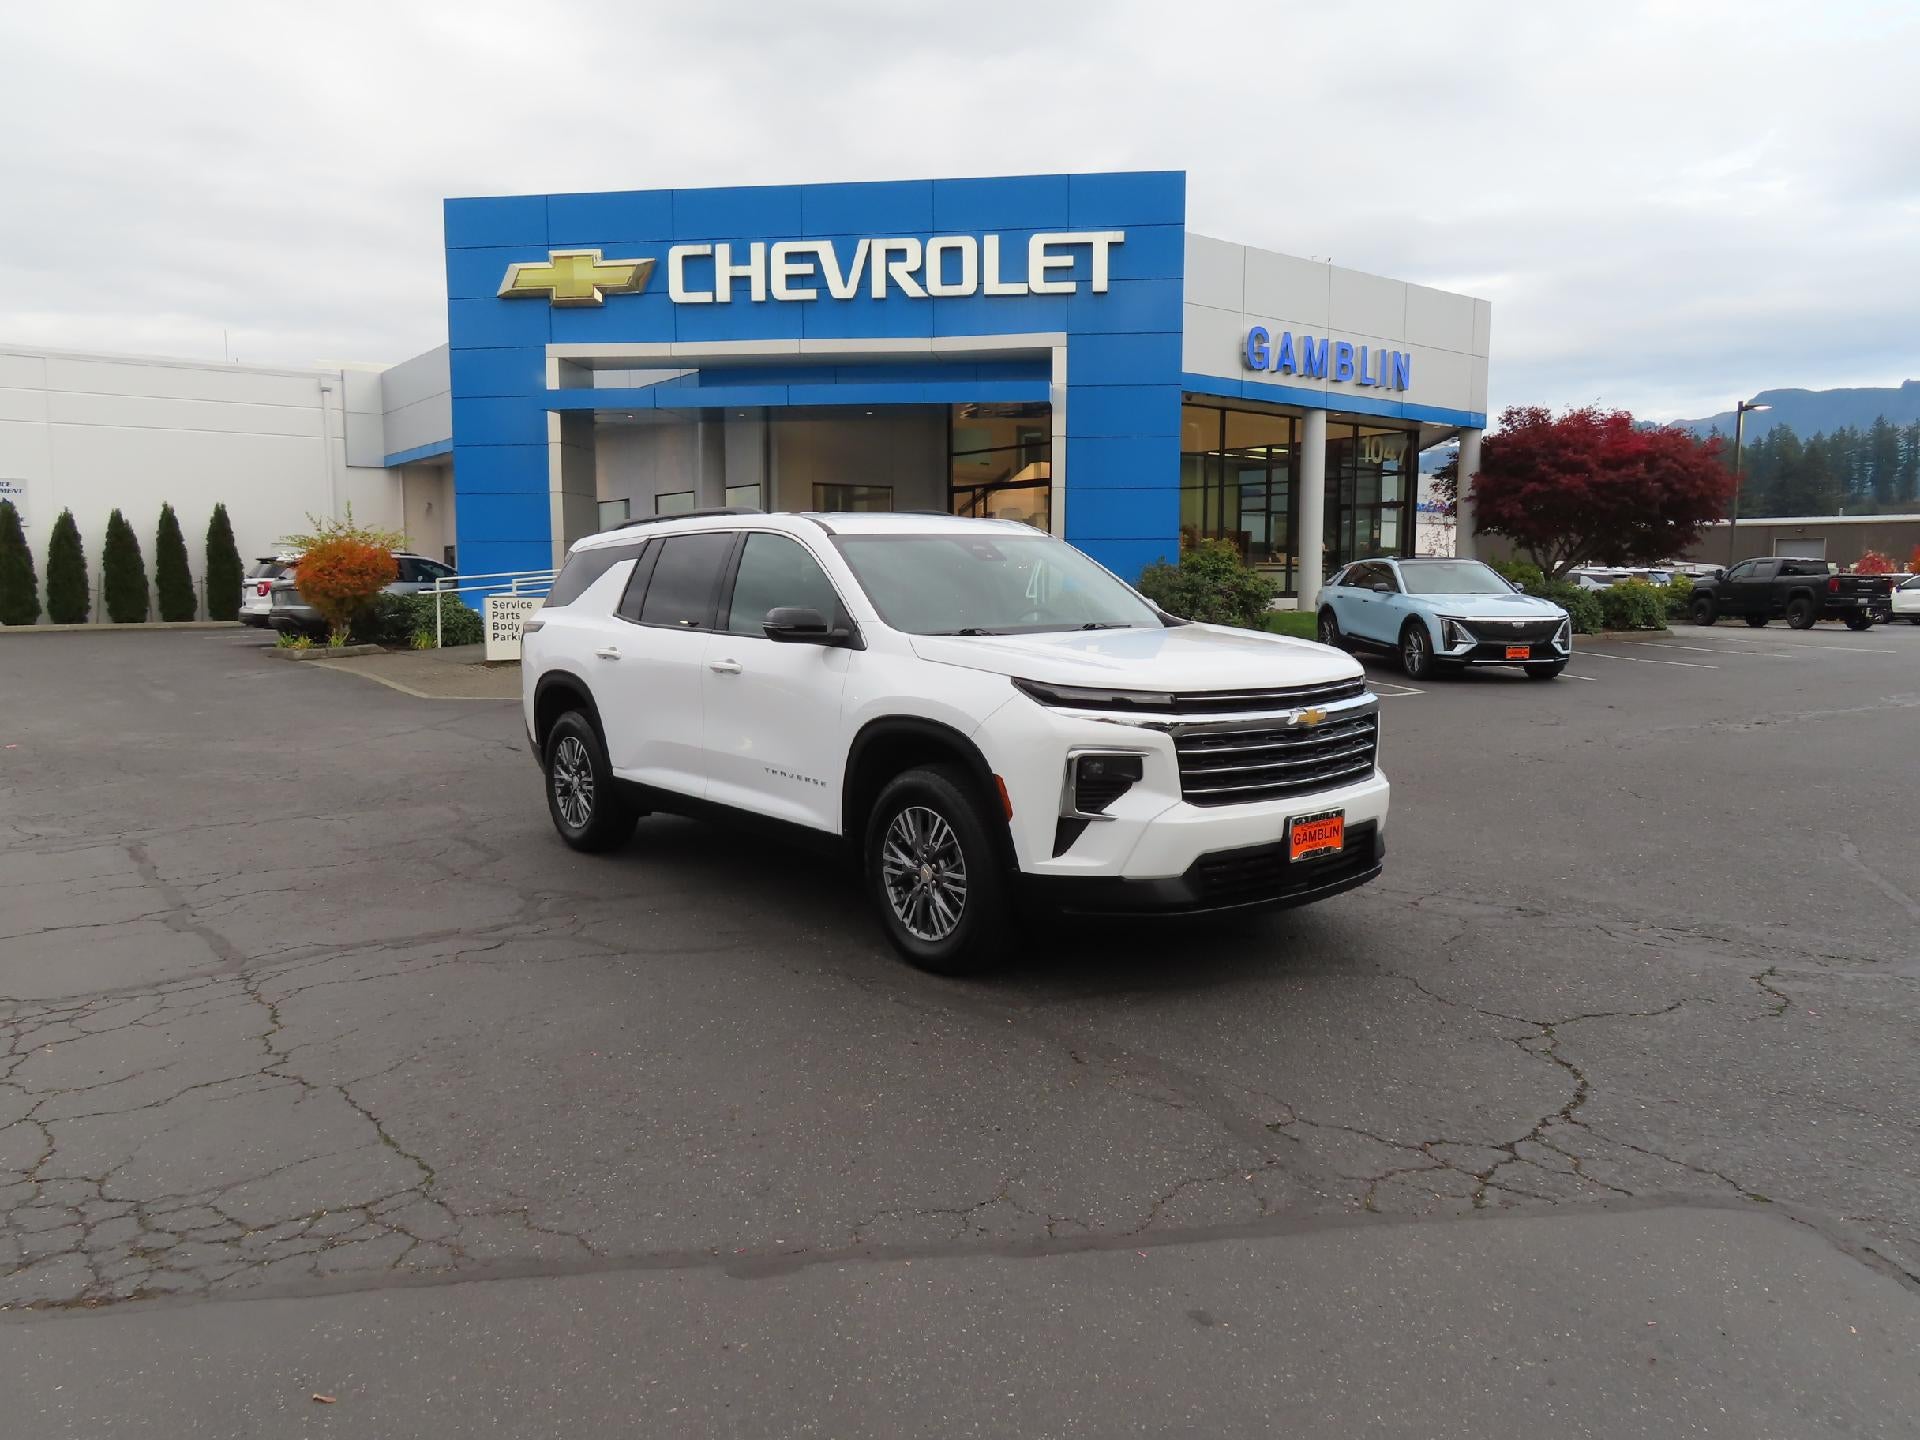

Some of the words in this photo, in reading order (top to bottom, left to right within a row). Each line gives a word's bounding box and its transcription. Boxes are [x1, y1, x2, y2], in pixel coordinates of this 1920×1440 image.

[668, 231, 1125, 303] CHEVROLET
[1246, 326, 1410, 391] GAMBLIN
[492, 600, 533, 609] Service
[492, 611, 521, 620] Parts
[492, 621, 521, 632] Body
[1293, 825, 1340, 846] GAMBLIN
